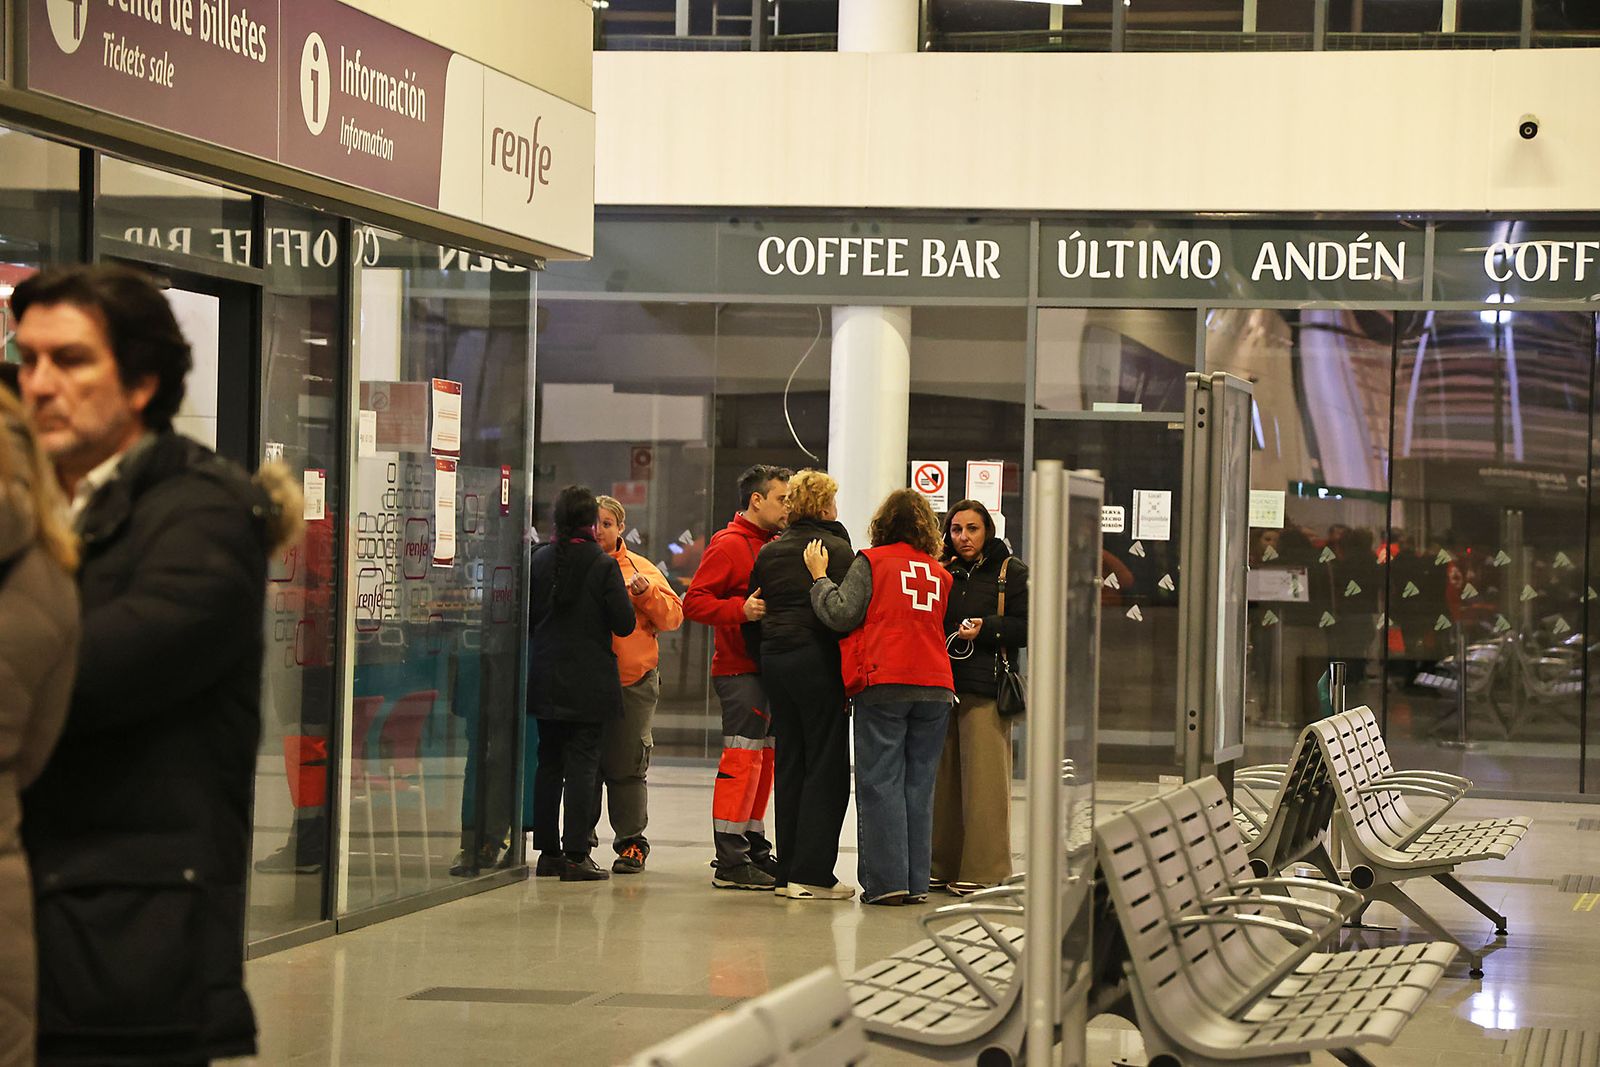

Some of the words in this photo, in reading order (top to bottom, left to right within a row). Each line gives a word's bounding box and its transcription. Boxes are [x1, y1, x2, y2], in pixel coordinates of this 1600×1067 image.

[170, 0, 193, 36] de
[200, 0, 267, 63] billetes
[103, 32, 146, 78] Tickets
[149, 51, 175, 88] sale
[340, 45, 427, 122] Información
[340, 116, 394, 161] Information
[491, 116, 552, 204] renfe
[758, 236, 910, 276] COFFEE
[921, 239, 1002, 279] BAR
[1058, 230, 1221, 280] ÚLTIMO
[1251, 231, 1407, 281] ANDÉN
[1484, 241, 1600, 282] COFF
[405, 535, 428, 563] renfe
[359, 584, 382, 616] renfe
